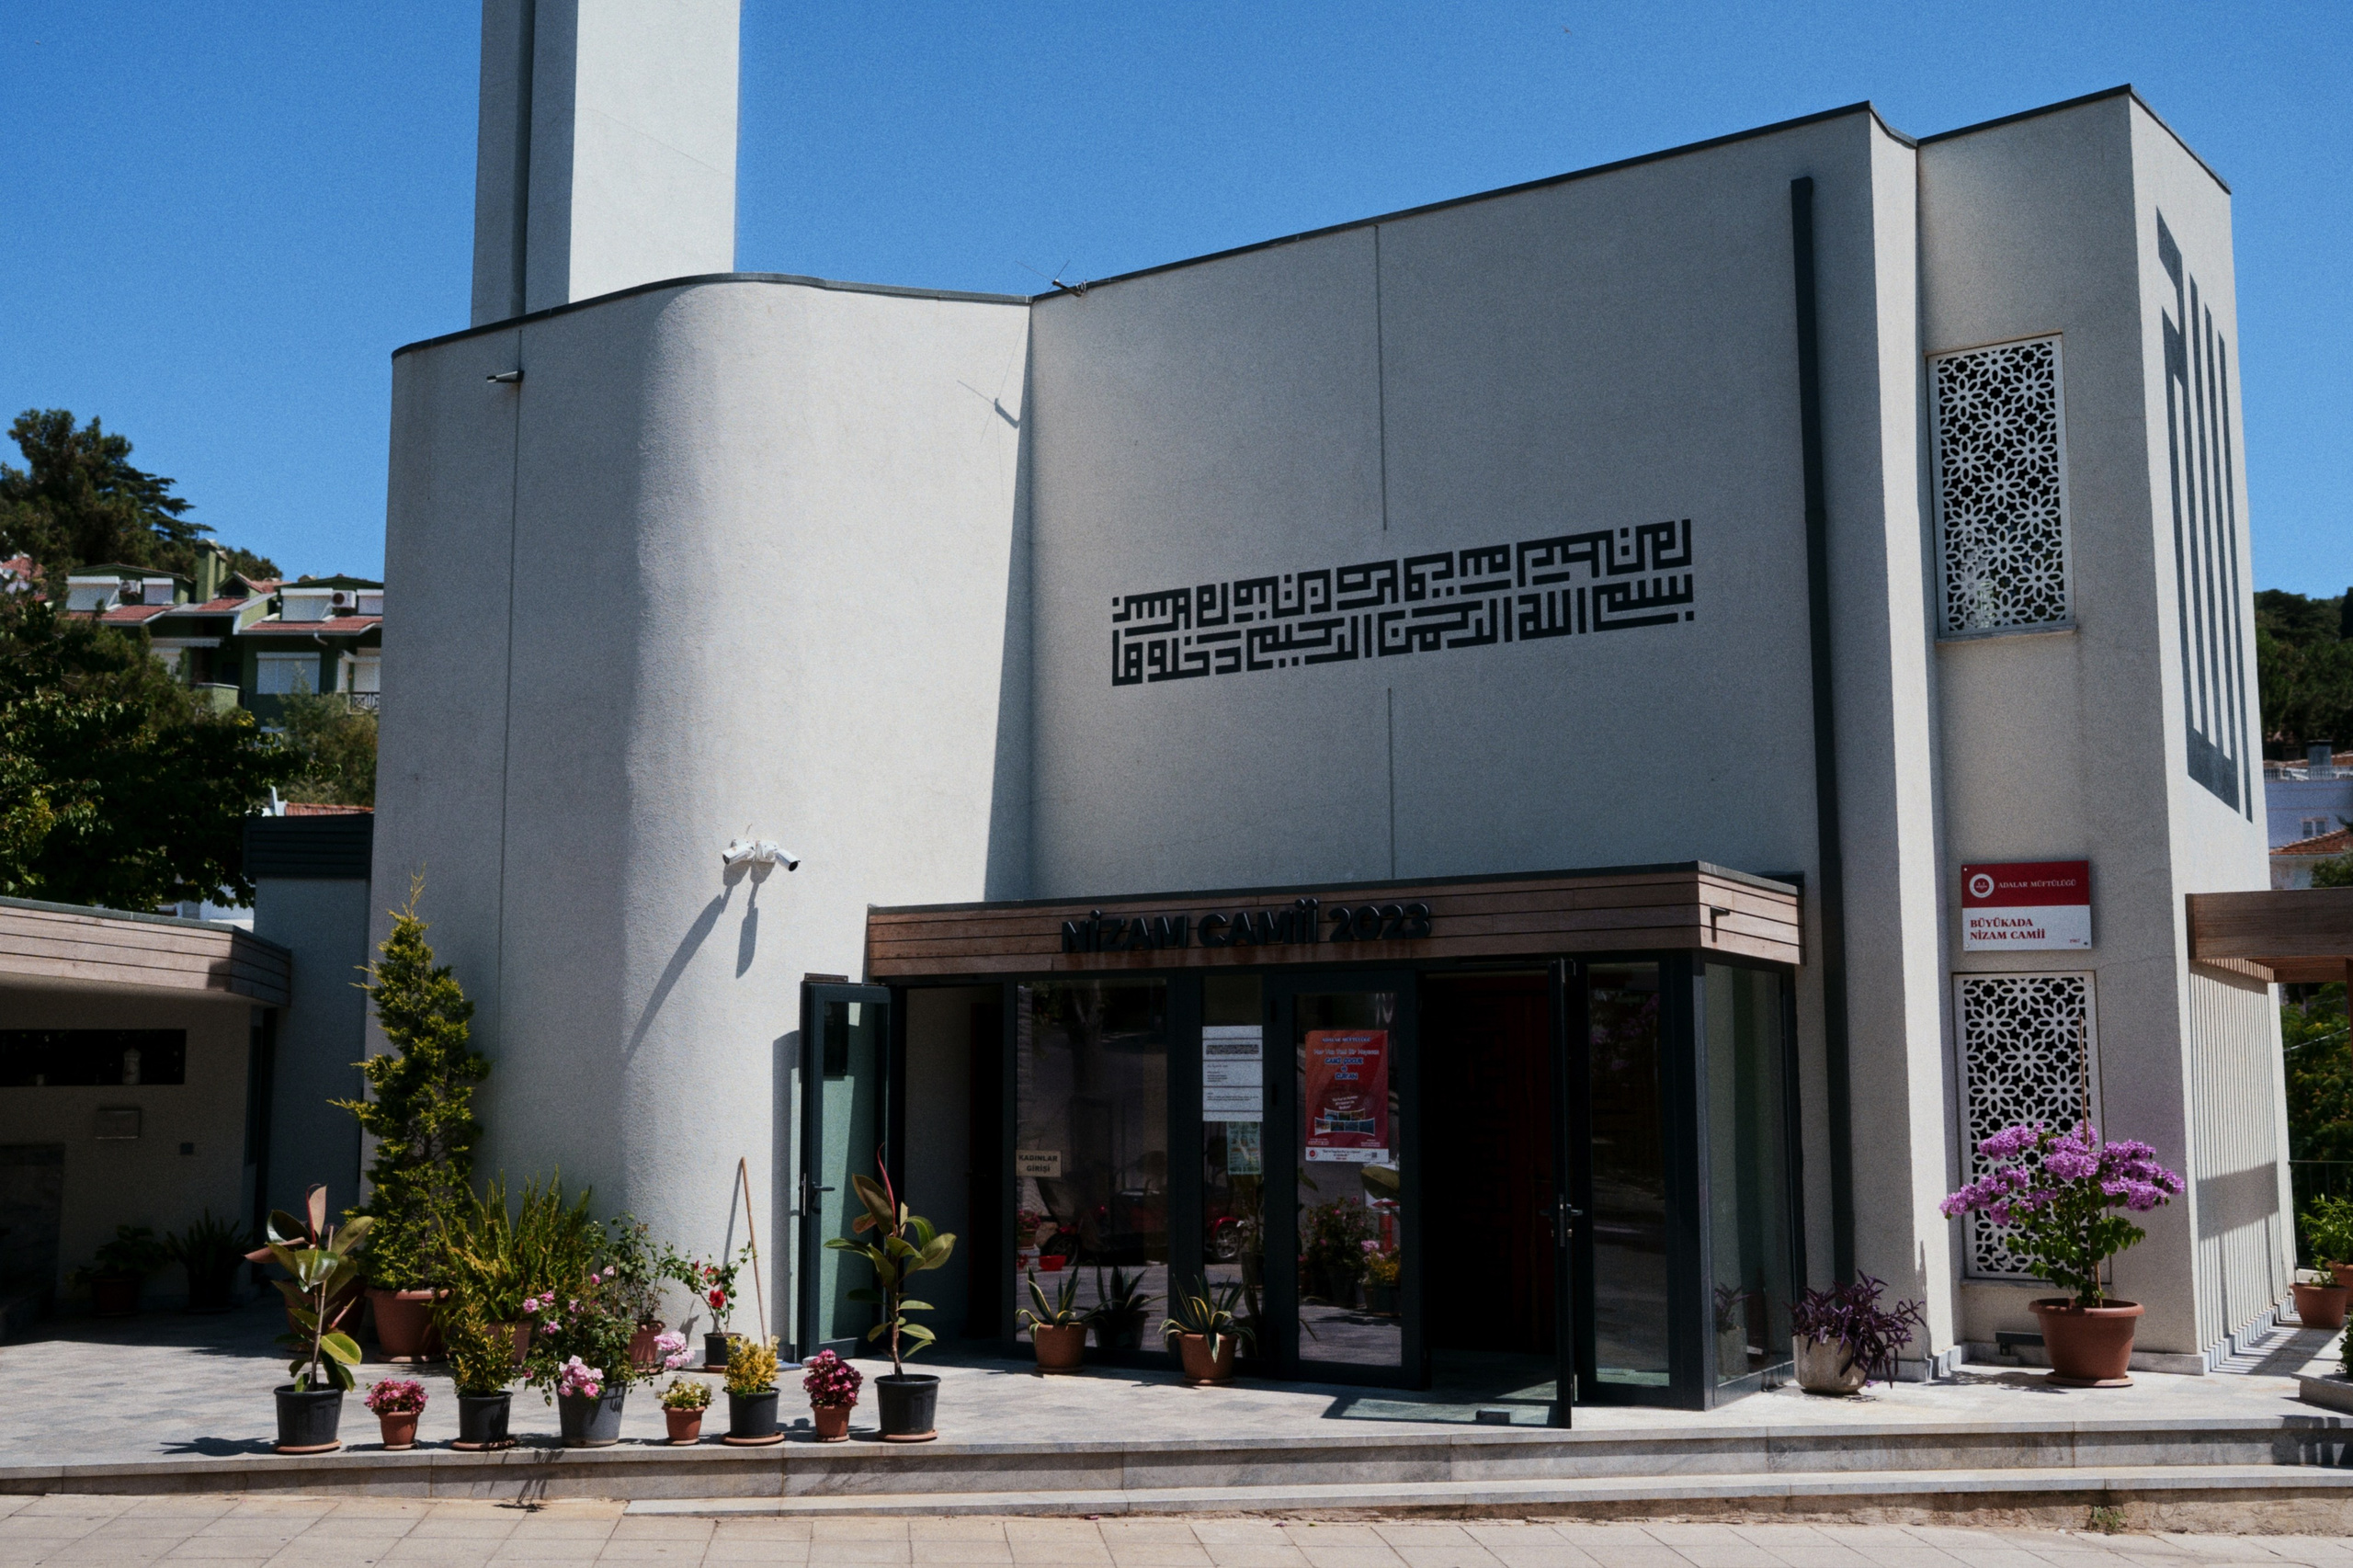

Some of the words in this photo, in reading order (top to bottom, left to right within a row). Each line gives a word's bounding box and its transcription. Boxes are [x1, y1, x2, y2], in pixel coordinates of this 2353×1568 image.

[1998, 881, 2028, 889] ADALAR
[2030, 879, 2076, 887] MÜFTÜLÜĞÜ
[1062, 909, 1189, 953] NİZAM
[1198, 898, 1319, 948] CAMİİ
[1328, 903, 1431, 942] 2023
[1970, 917, 2033, 927] BÜYÜKADA
[1970, 929, 2006, 940] NİZAM
[2010, 928, 2045, 939] CAMİİ
[1027, 1165, 1051, 1174] GİRİŞİ
